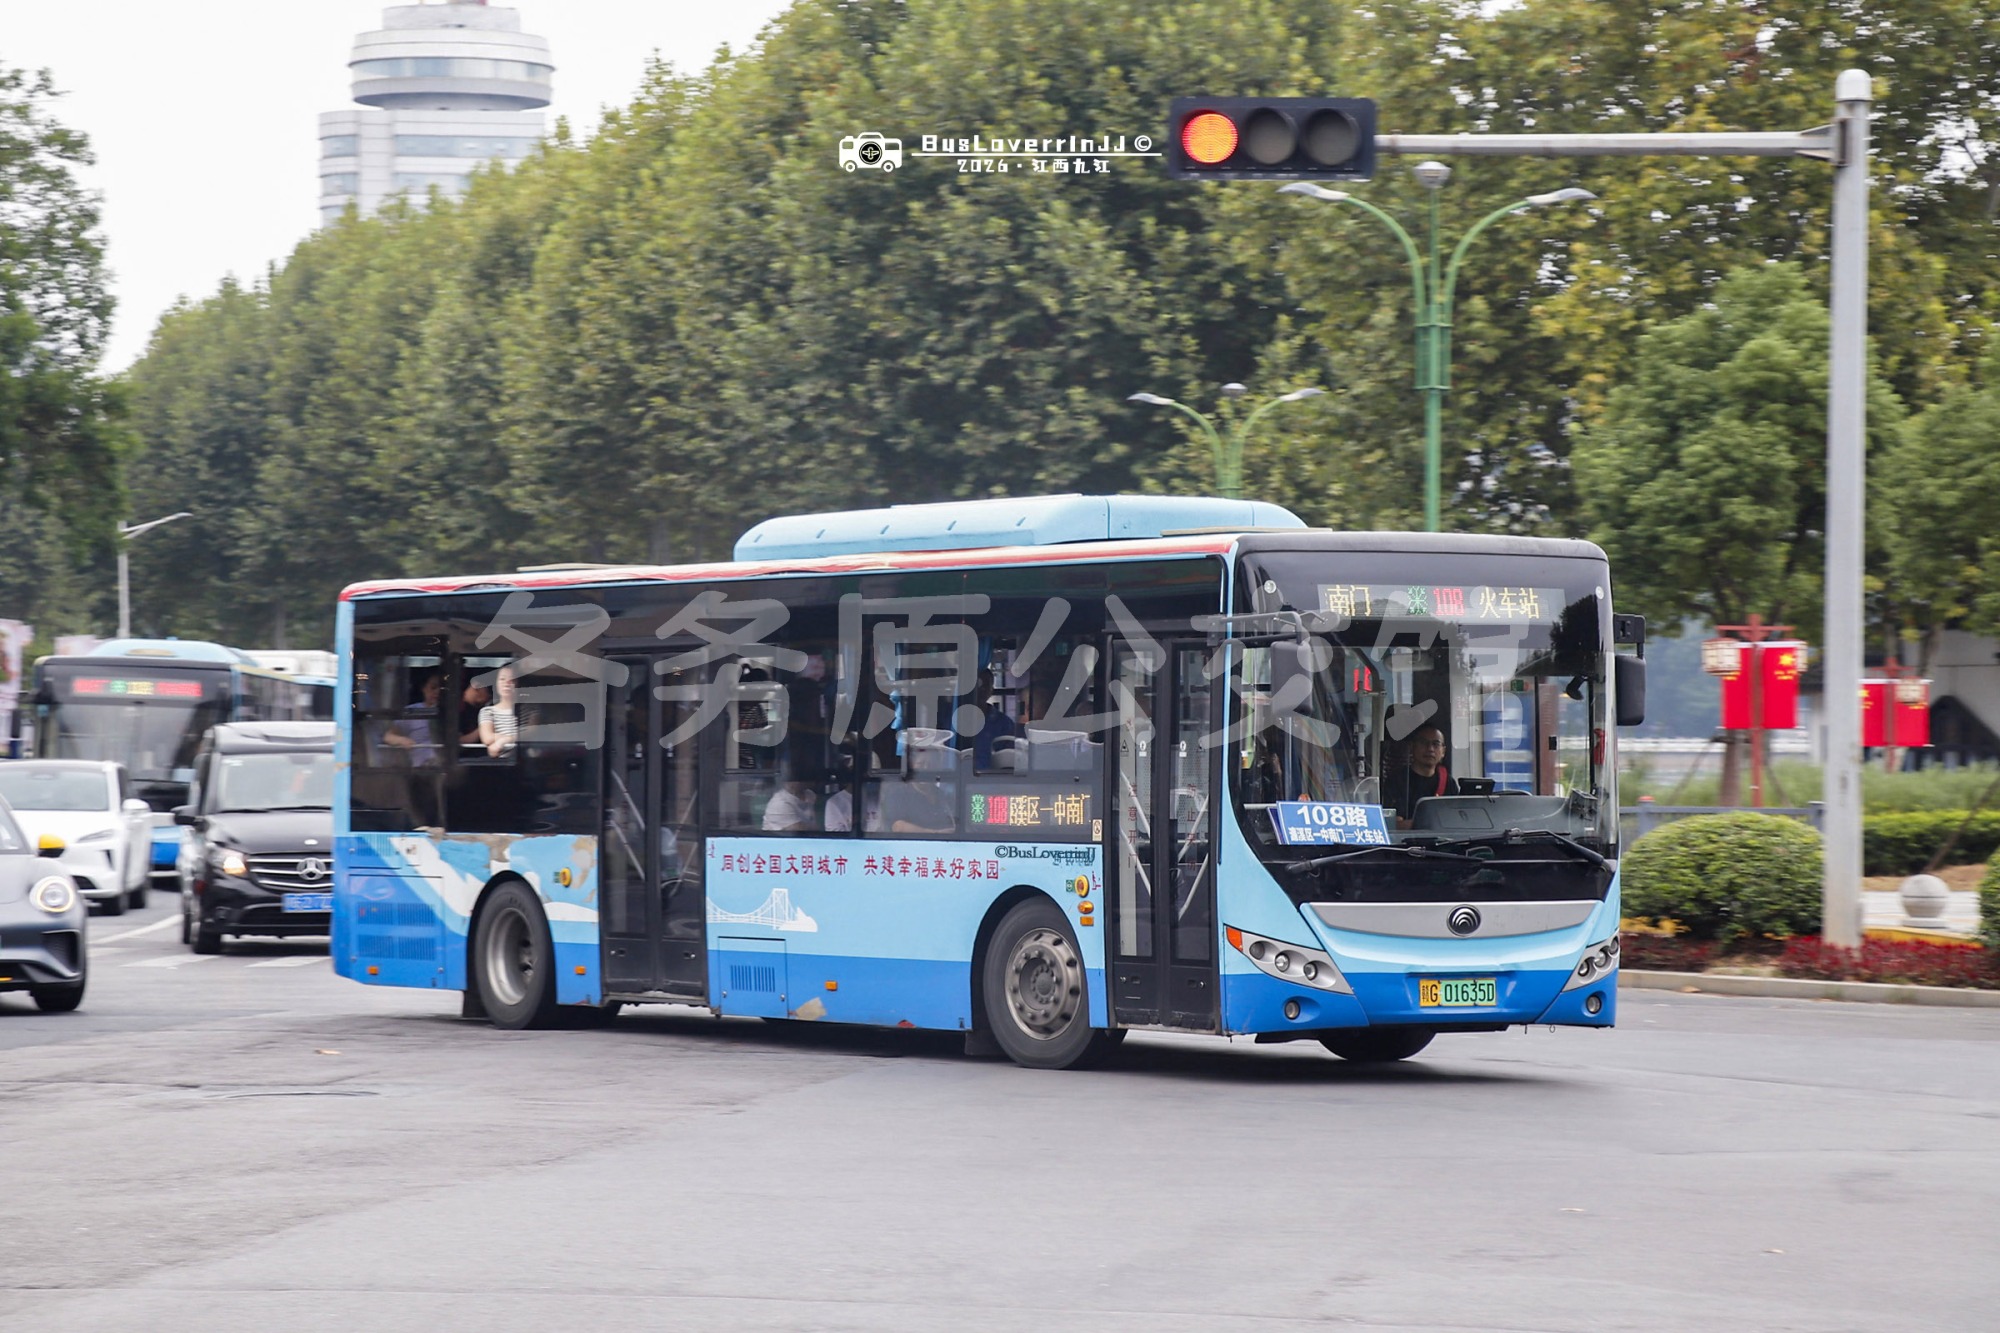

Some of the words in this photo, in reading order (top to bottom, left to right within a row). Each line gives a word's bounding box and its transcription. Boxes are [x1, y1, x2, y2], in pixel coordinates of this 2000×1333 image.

[1433, 588, 1465, 616] 108
[1479, 587, 1540, 619] 火车站
[1297, 805, 1368, 827] 108路
[721, 853, 848, 875] 同创全国文明城市
[864, 855, 999, 879] 共建幸福美好家园
[1444, 983, 1495, 1002] 01635D
